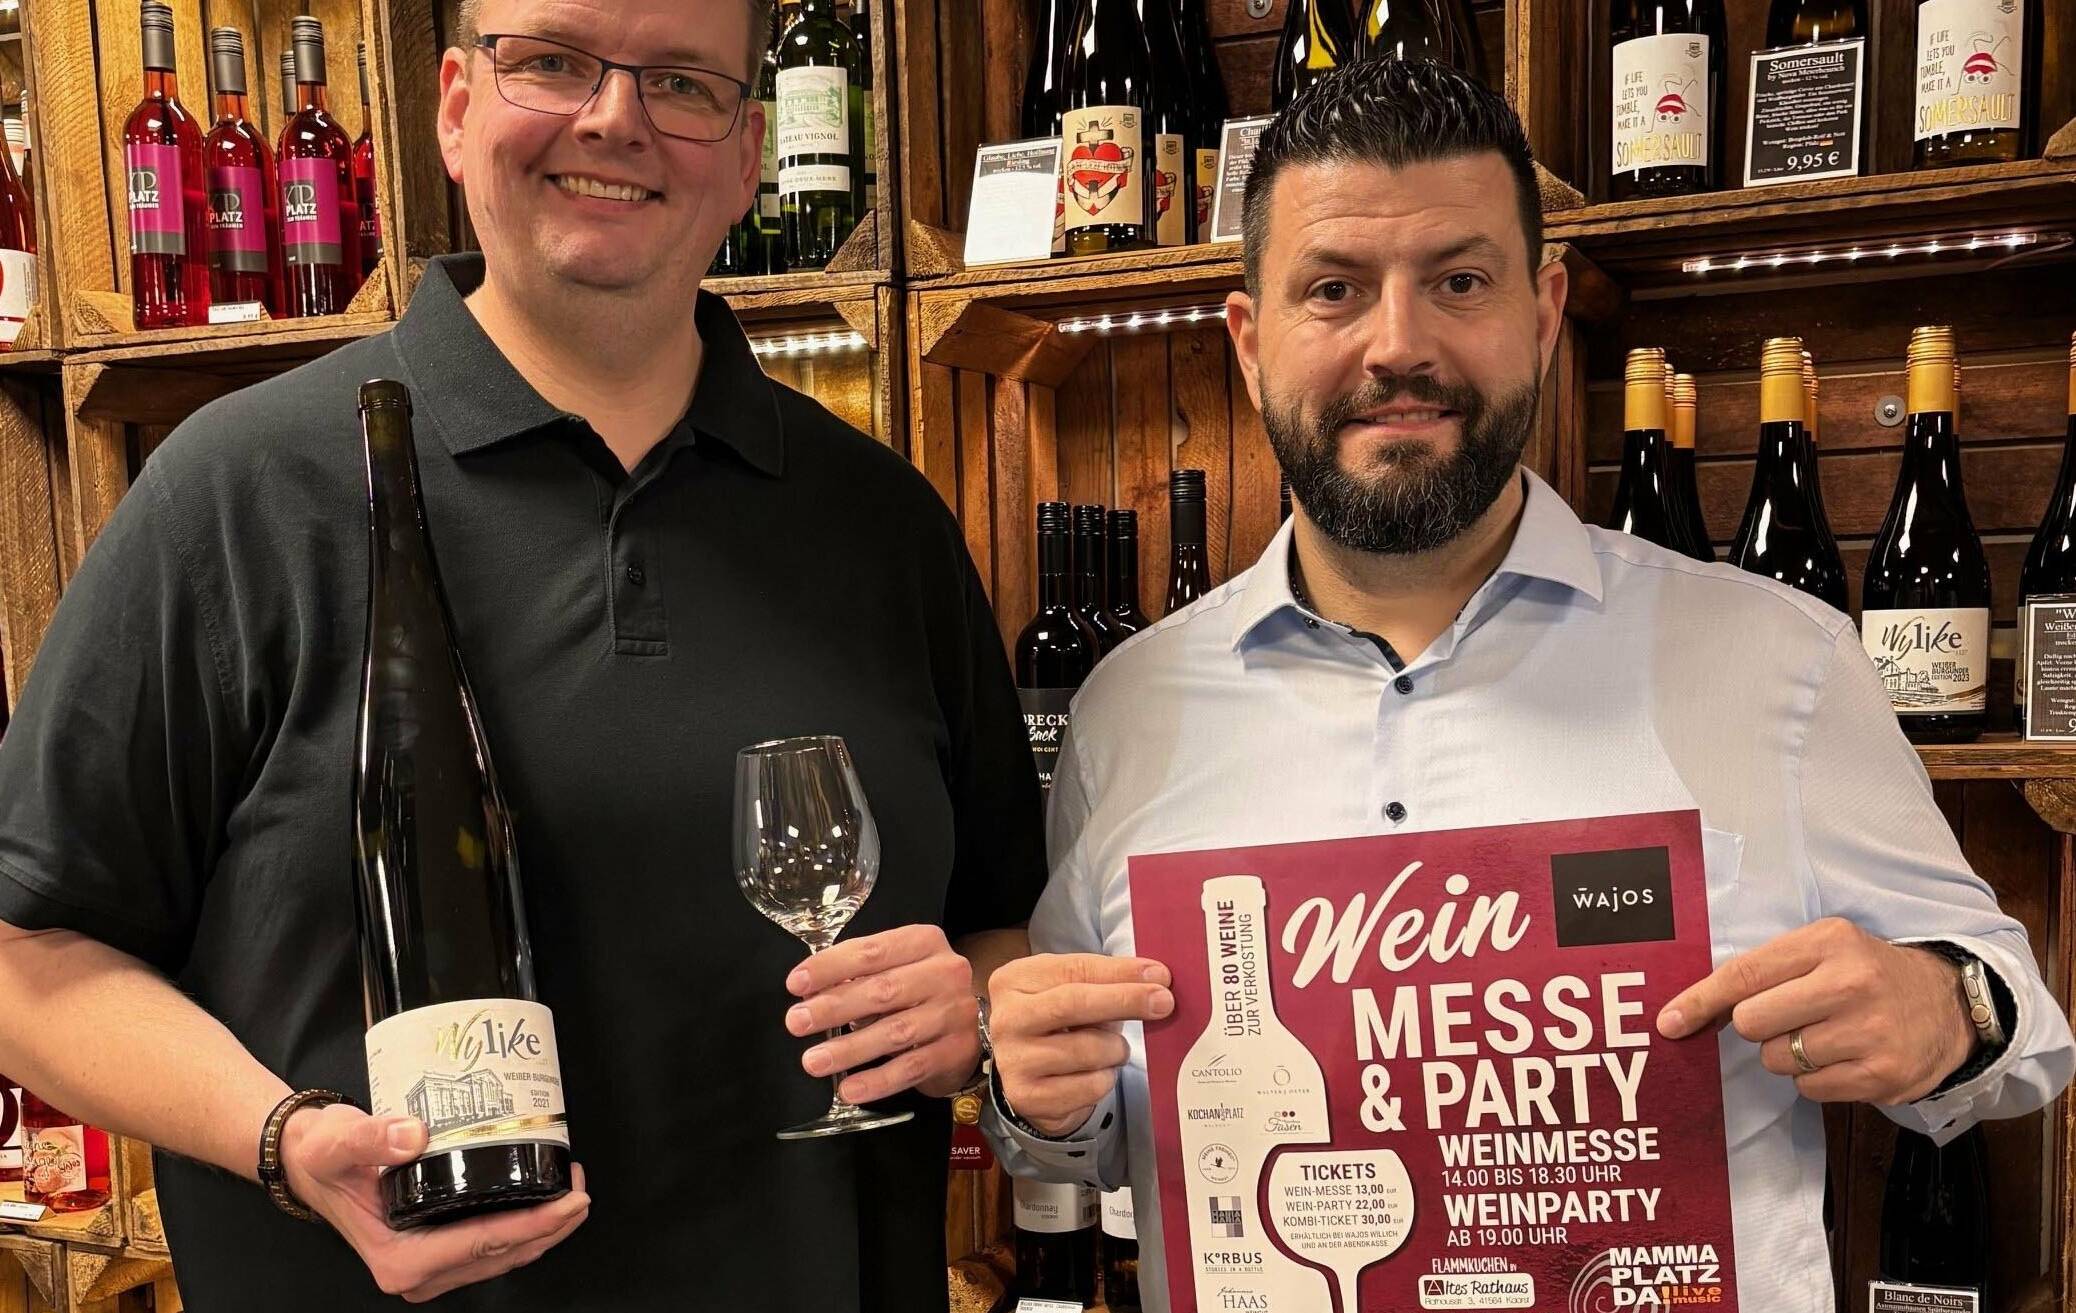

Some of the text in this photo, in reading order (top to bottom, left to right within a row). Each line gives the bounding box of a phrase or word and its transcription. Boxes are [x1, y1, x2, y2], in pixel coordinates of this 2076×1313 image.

[1769, 52, 1845, 72] Somersault
[1767, 73, 1777, 82] by
[1635, 85, 1648, 97] YOU
[1919, 93, 2015, 133] SOMERSAULT
[1616, 132, 1702, 168] SOMERSAULT
[1787, 153, 1823, 171] 9,95
[1828, 150, 1840, 165] €
[209, 211, 244, 224] PLATZ
[285, 203, 317, 217] PLATZ
[1881, 615, 1962, 661] Wylike
[1952, 673, 1970, 682] 2023
[1029, 726, 1058, 742] Sack
[1281, 860, 1531, 990] Wein
[1217, 899, 1244, 1037] ÜBER 80 WEINE
[1239, 912, 1262, 1036] ZUR VERKOSTUNG
[1351, 971, 1651, 1061] MESSE
[435, 1008, 542, 1073] Wylike
[1191, 1068, 1243, 1078] CANTOLIO
[1360, 1050, 1650, 1133] & PARTY
[532, 1097, 551, 1109] 2021
[951, 1146, 981, 1155] SAVER
[1438, 1127, 1661, 1168] WEINMESSE
[1300, 1162, 1377, 1181] TICKETS
[1441, 1164, 1623, 1188] 14.00 BIS 18.30 UHR
[1284, 1184, 1352, 1197] WEIN-MESSE
[1355, 1183, 1384, 1196] 13,00
[1285, 1200, 1353, 1212] WEIN-PARTY
[1355, 1198, 1385, 1211] 22,00
[1443, 1187, 1662, 1227] WEINPARTY
[1283, 1214, 1358, 1227] KOMBI-TICKET
[1361, 1213, 1391, 1227] 30,00
[1290, 1229, 1398, 1240] ERHÄLTLICH BEI WAJOS WILLICH
[1447, 1226, 1569, 1247] AB 19.00 UHR
[1301, 1239, 1389, 1249] UND AN DER ABENDKASSE
[1609, 1244, 1720, 1267] MAMMA
[1432, 1257, 1509, 1274] FLAMMKUCHEN
[1611, 1264, 1721, 1287] PLATZ
[1470, 1279, 1529, 1296] Rathaus
[1672, 1285, 1722, 1298] live
[1223, 1294, 1269, 1309] HAAS
[1479, 1296, 1502, 1305] 41564
[1673, 1294, 1722, 1306] music
[1884, 1290, 1964, 1307] Blanc de Noirs
